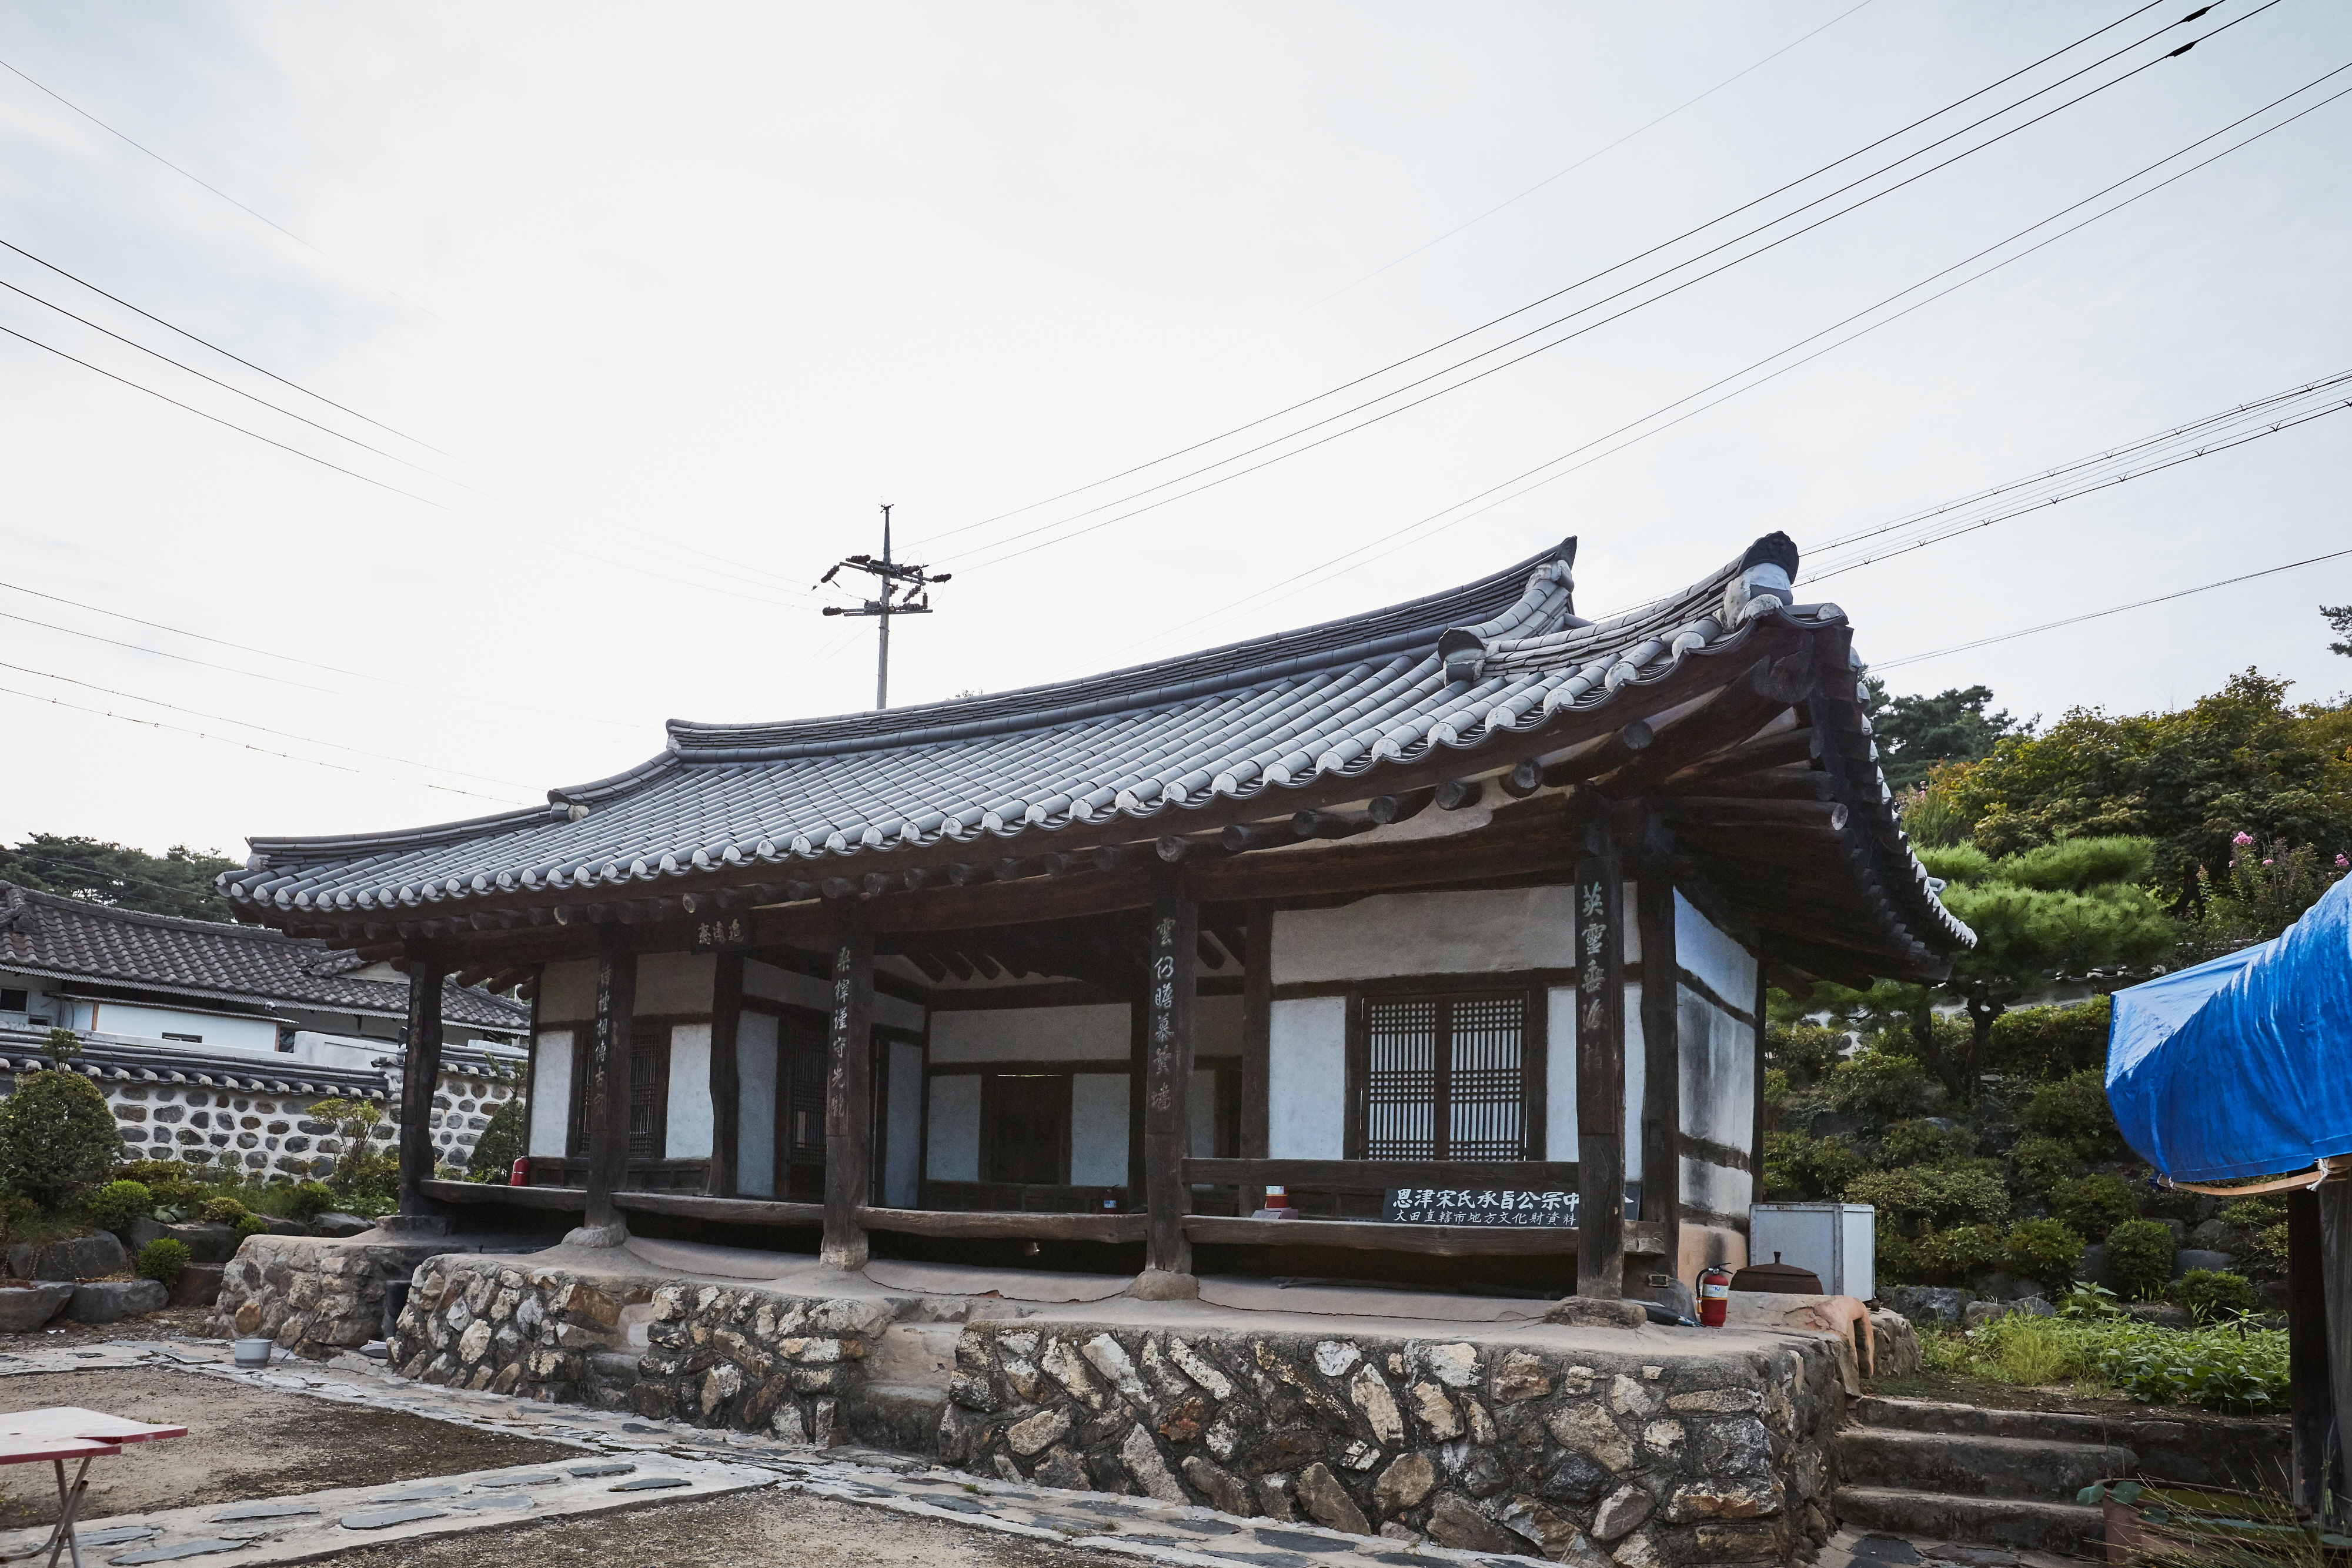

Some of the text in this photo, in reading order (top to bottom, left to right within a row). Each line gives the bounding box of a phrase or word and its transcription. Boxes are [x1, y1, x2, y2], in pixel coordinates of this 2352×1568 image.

[1394, 1209, 1576, 1226] 大田直轄市地方文化財資料
